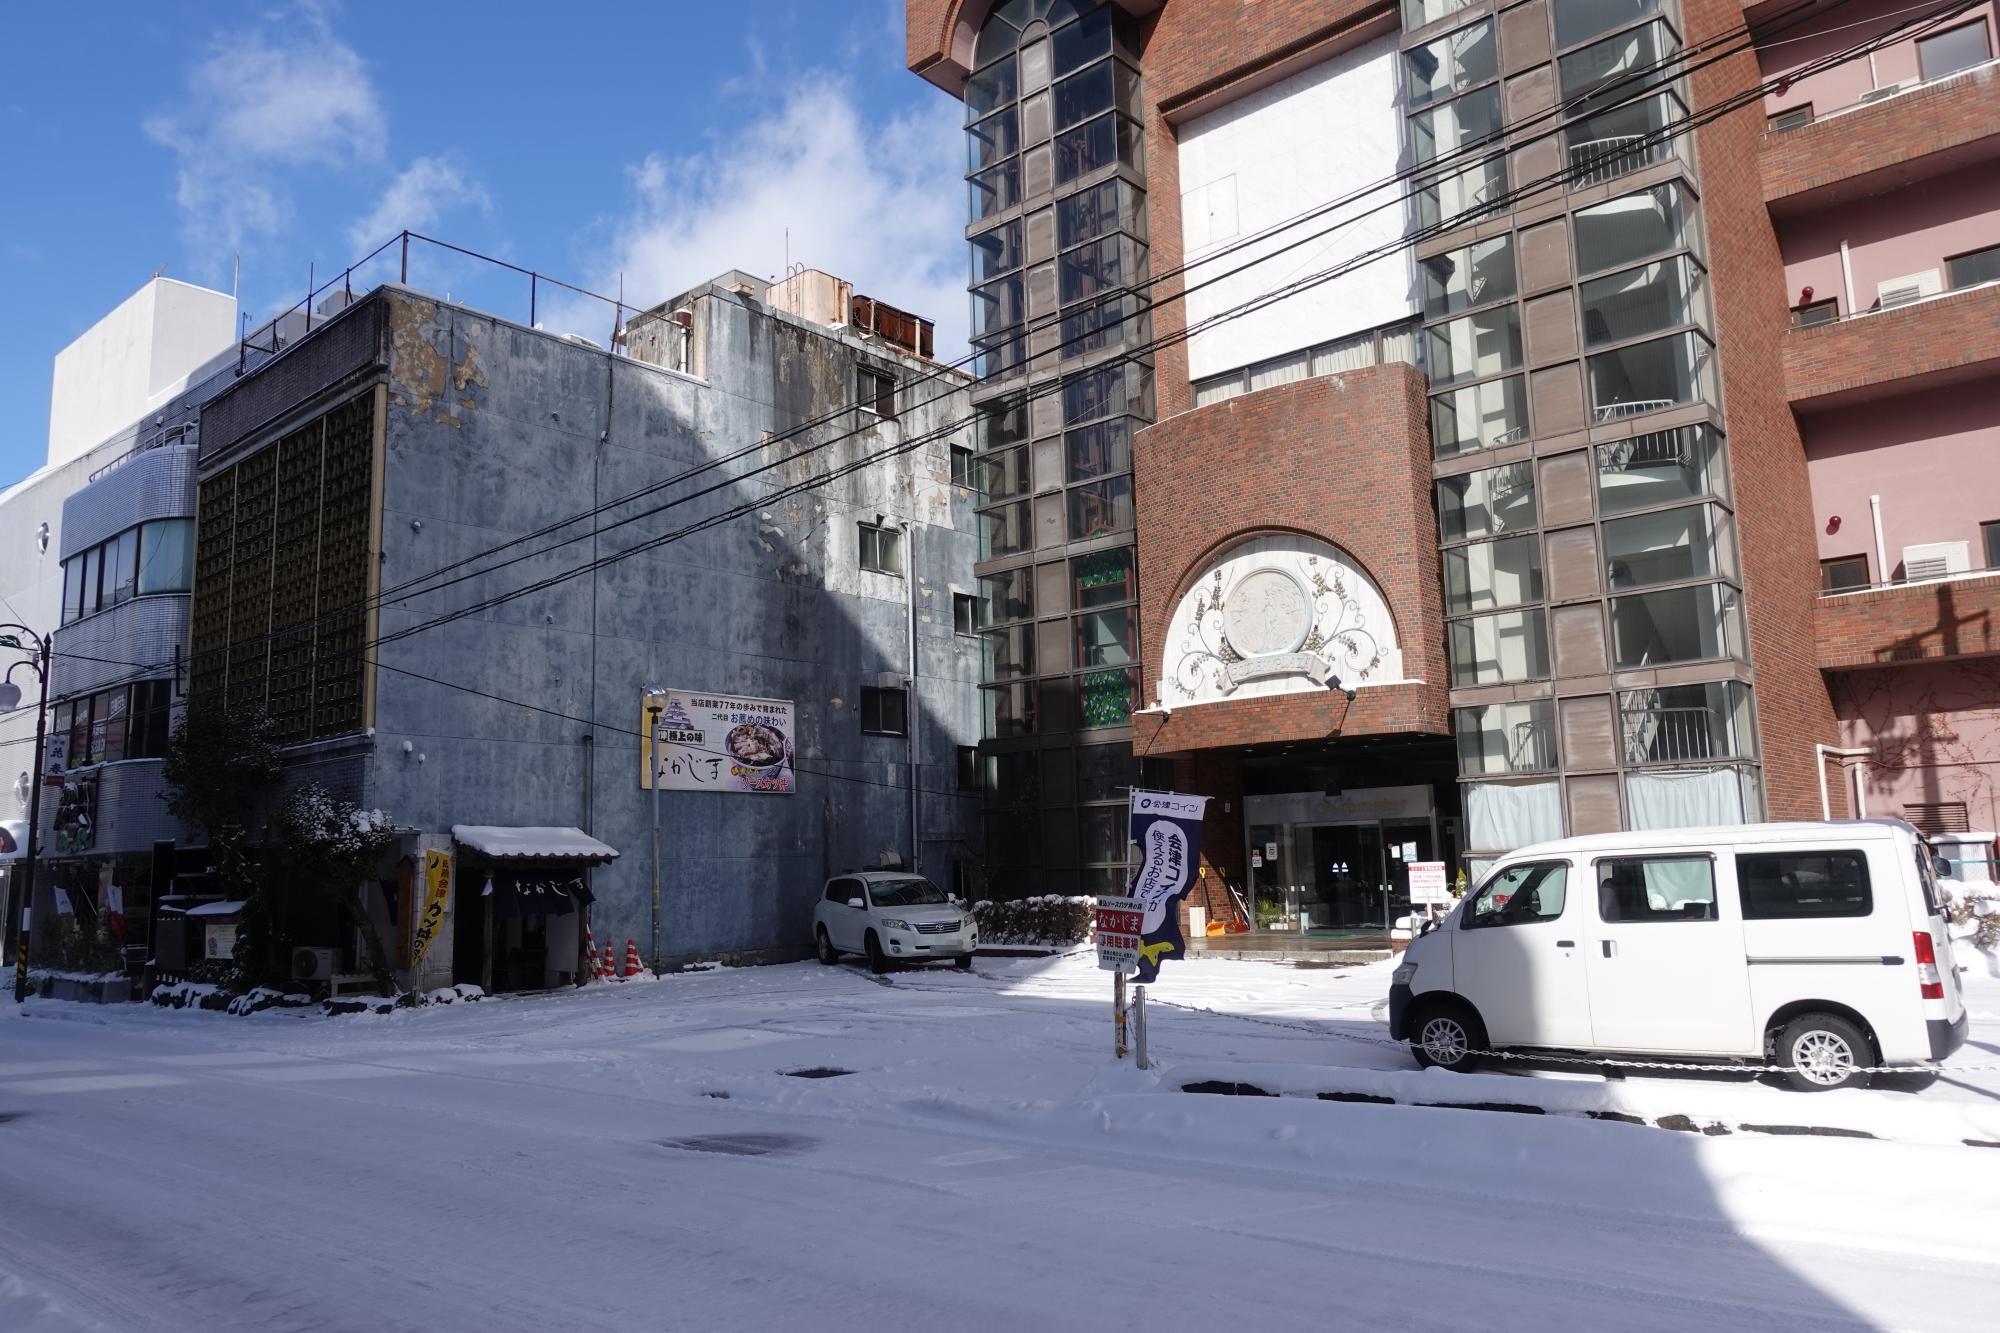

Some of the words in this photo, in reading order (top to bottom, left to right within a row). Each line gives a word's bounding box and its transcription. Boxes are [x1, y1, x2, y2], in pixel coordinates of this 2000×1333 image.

[691, 698, 788, 715] 当店創業77年の歩みで育まれた
[711, 713, 729, 722] 二代目
[1152, 800, 1198, 813] 会津コイン
[1099, 912, 1139, 933] なかじま
